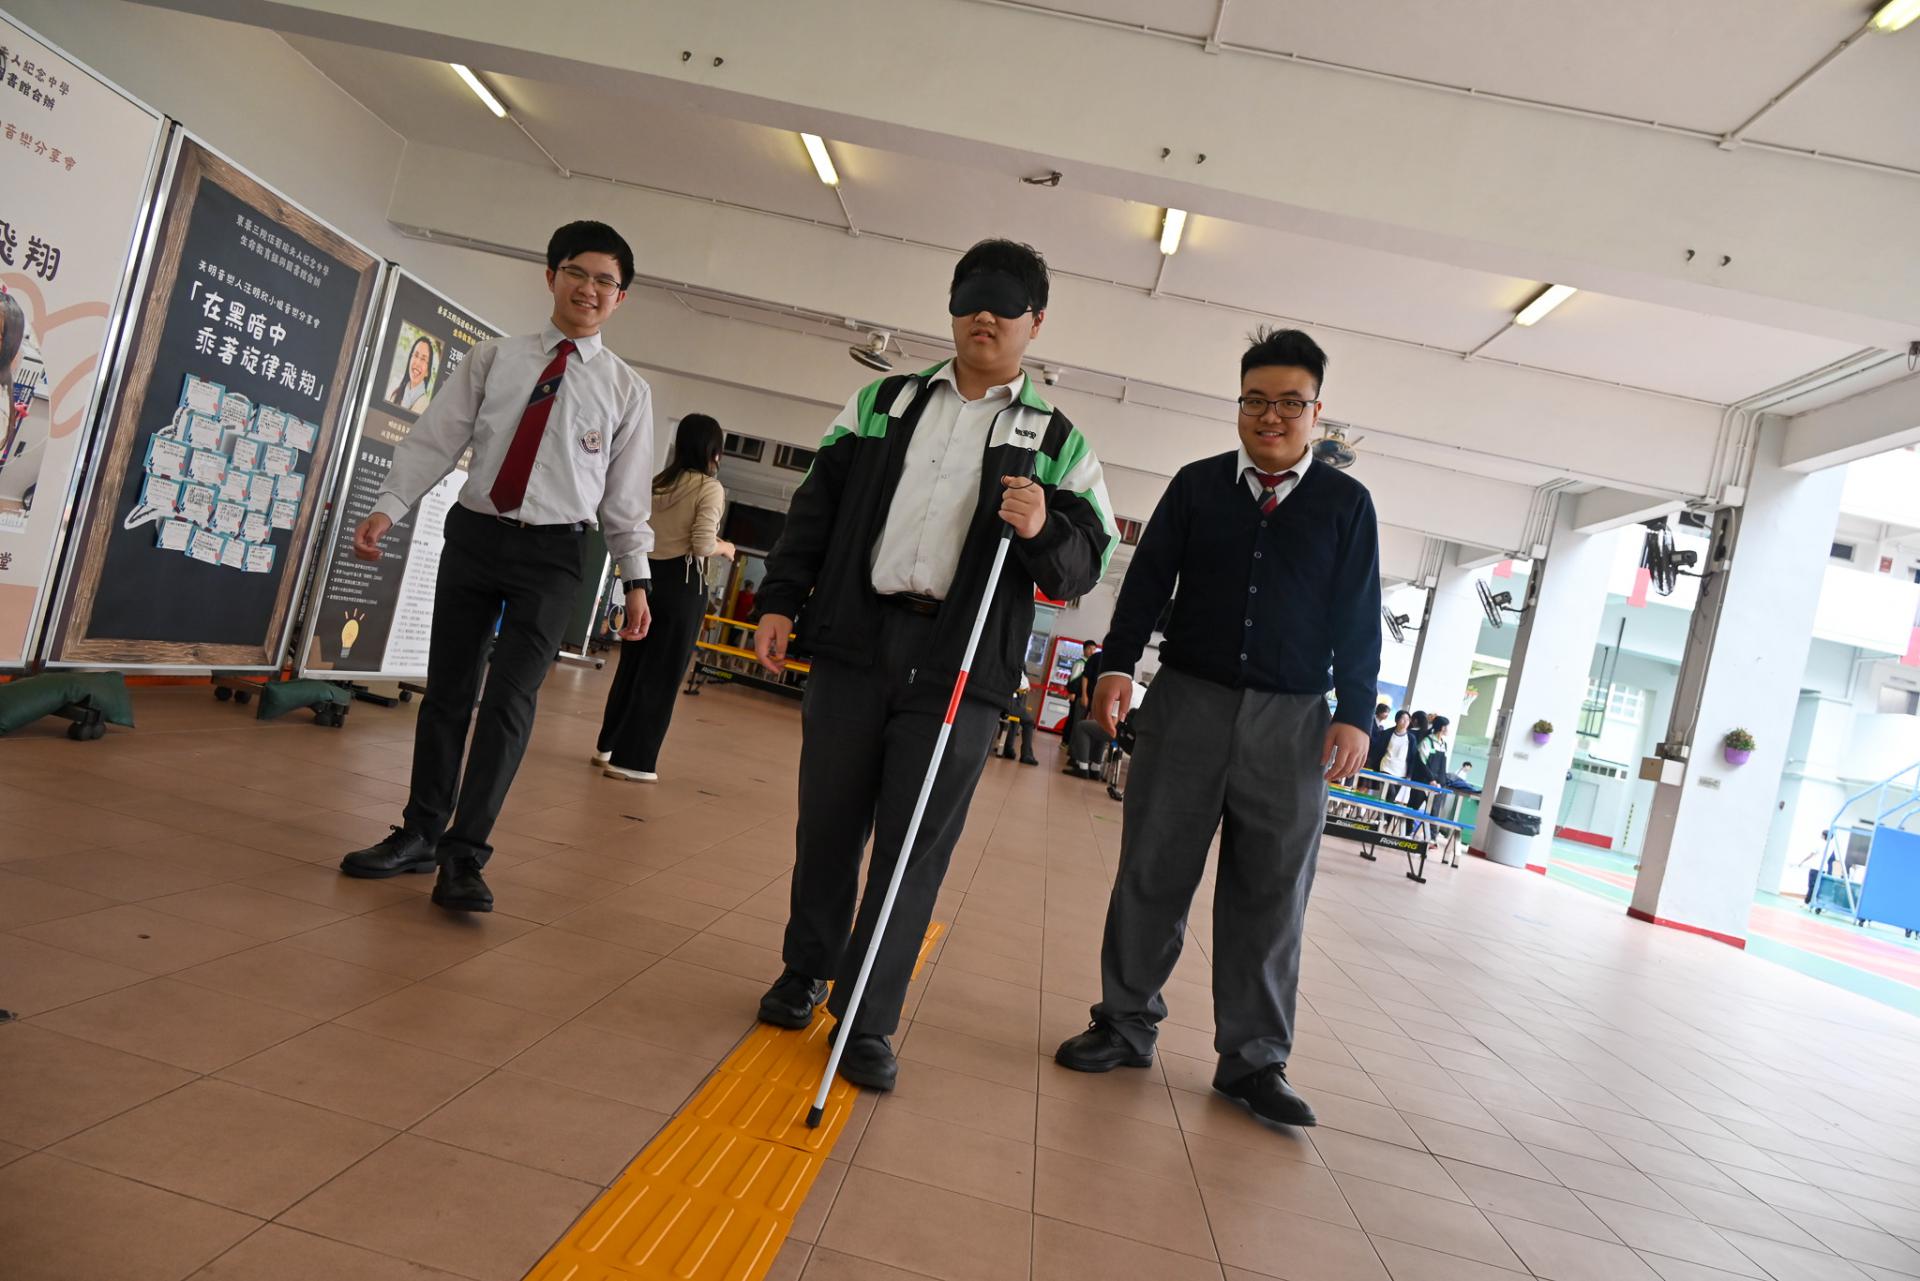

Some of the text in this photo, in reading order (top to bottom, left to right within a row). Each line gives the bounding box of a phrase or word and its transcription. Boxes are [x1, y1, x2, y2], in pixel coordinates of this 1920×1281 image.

[0, 120, 77, 171] 音樂分享會
[190, 281, 287, 346] 「在黑暗中
[195, 327, 325, 401] 乘著旋律飛翔」
